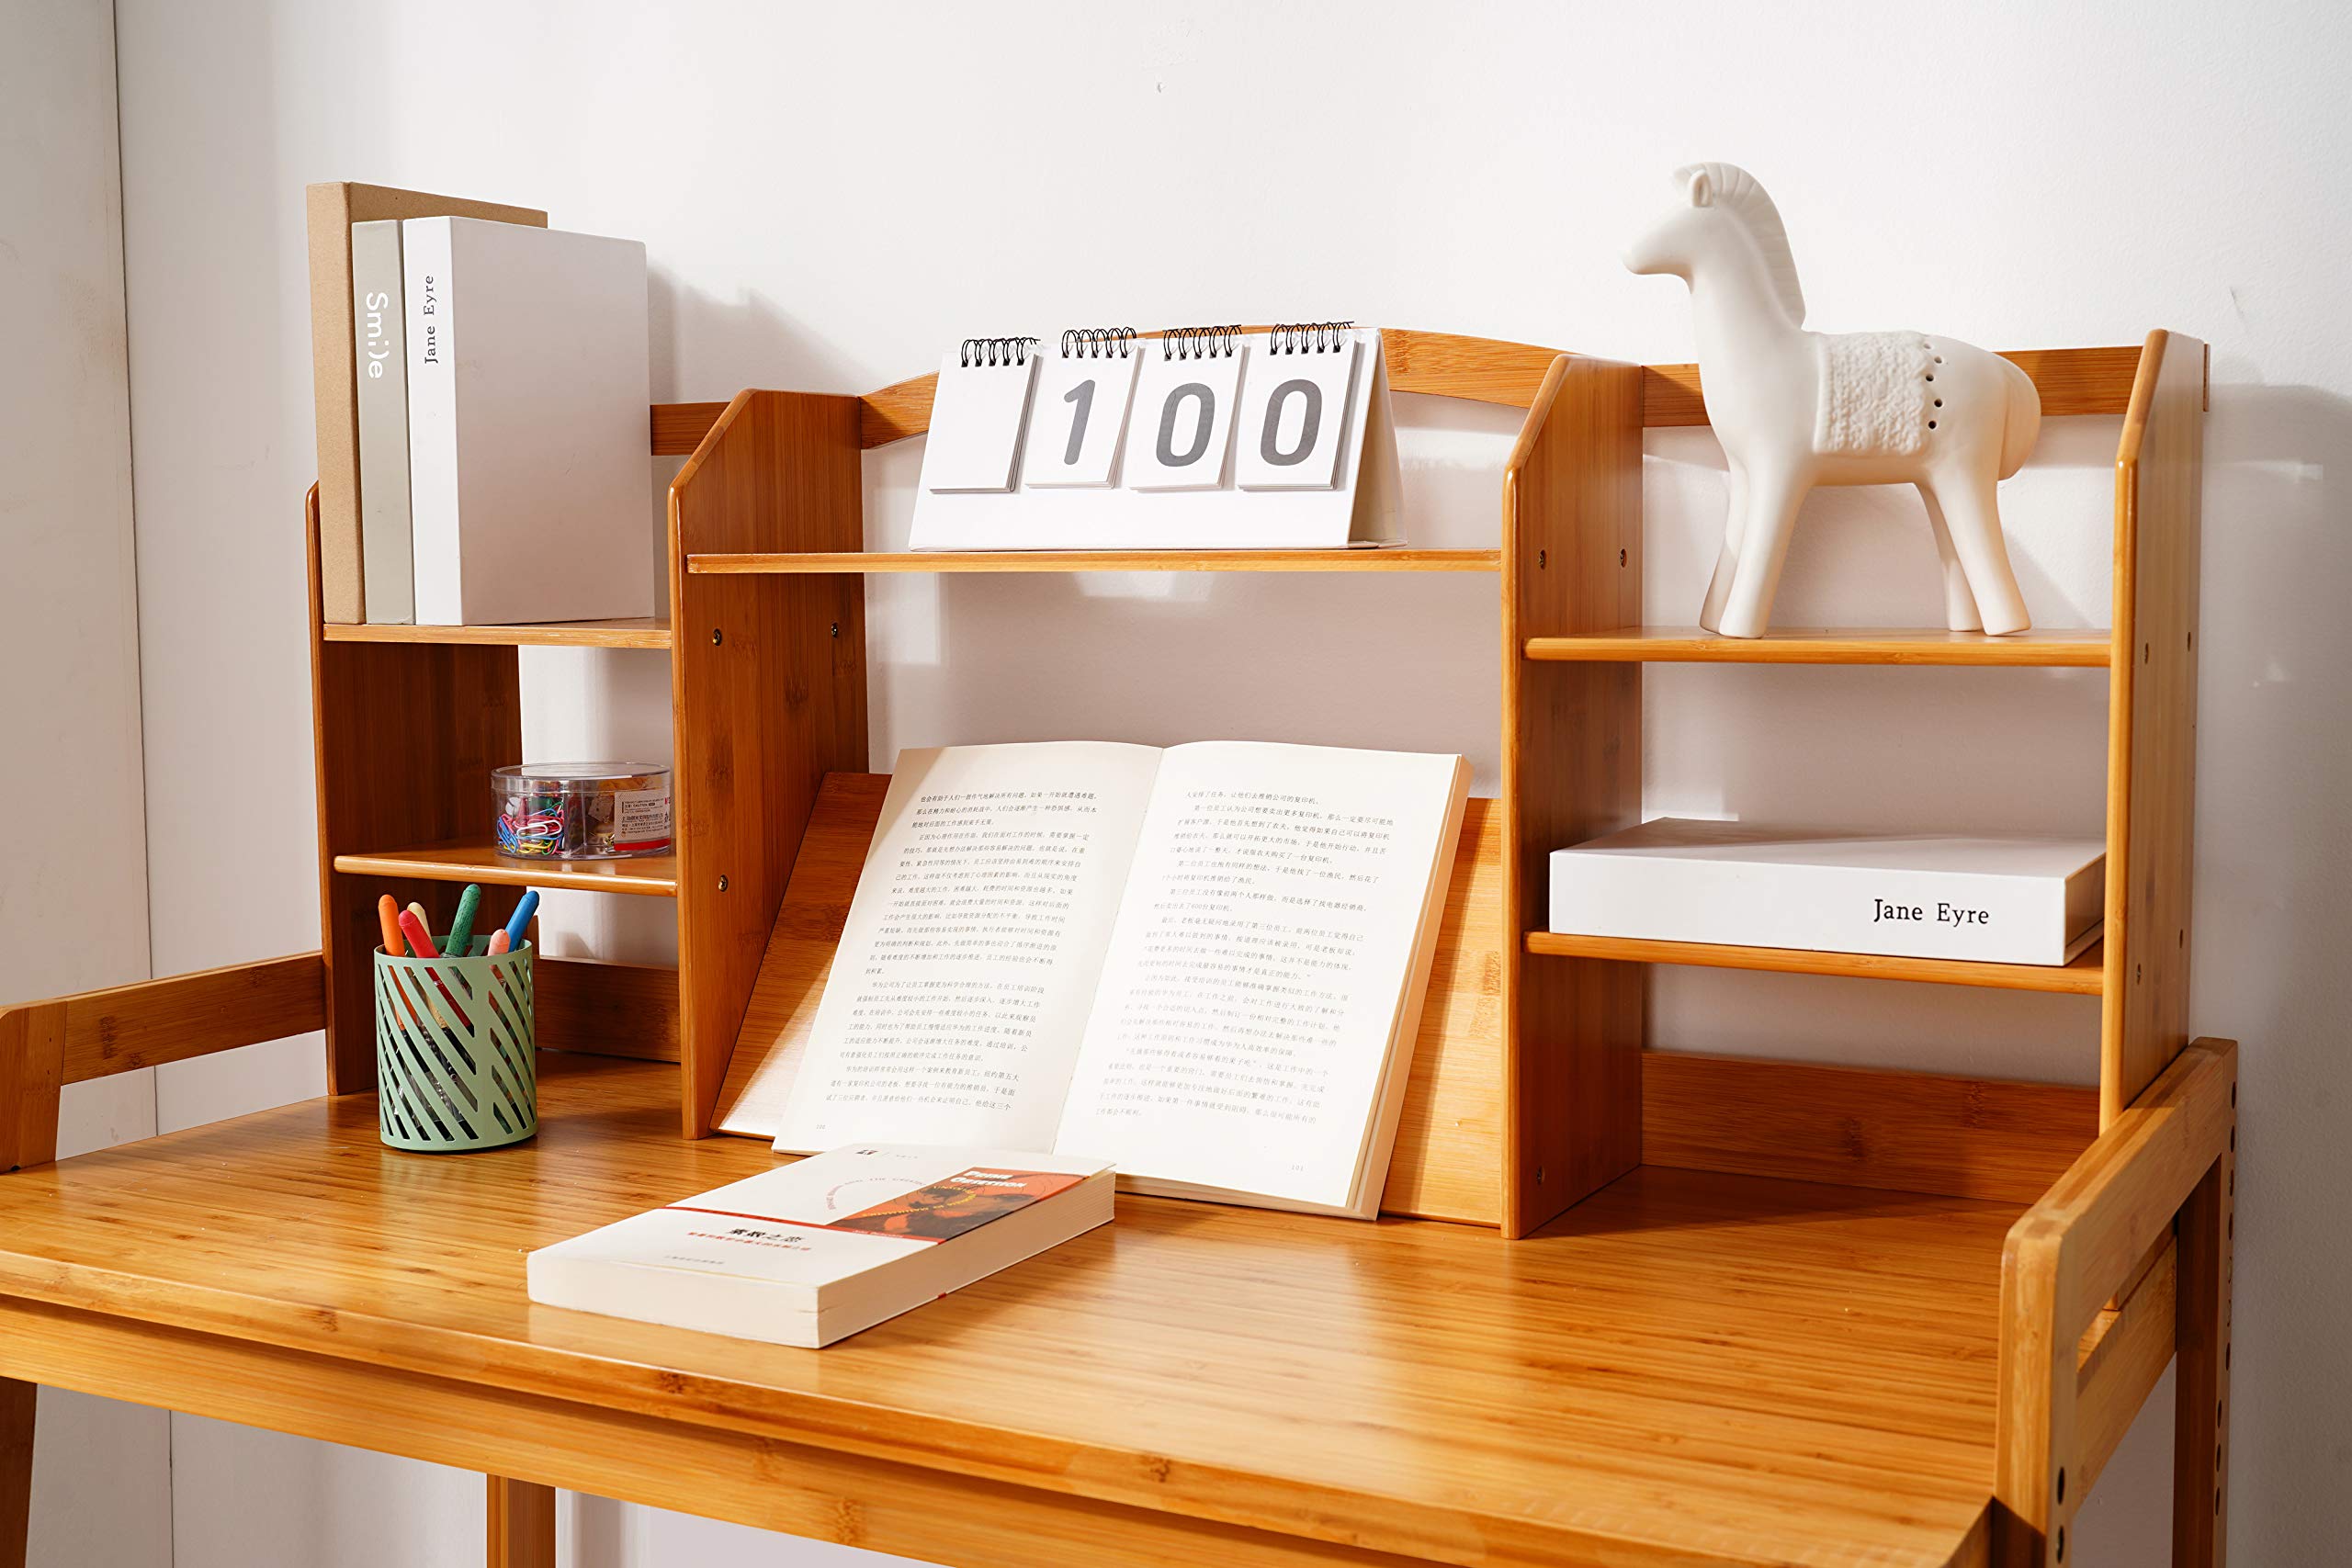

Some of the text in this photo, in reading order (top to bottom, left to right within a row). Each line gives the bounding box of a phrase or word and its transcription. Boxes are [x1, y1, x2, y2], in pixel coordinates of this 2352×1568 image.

[423, 275, 439, 365] Jane Eyre
[1873, 898, 1989, 928] Jane Eyre
